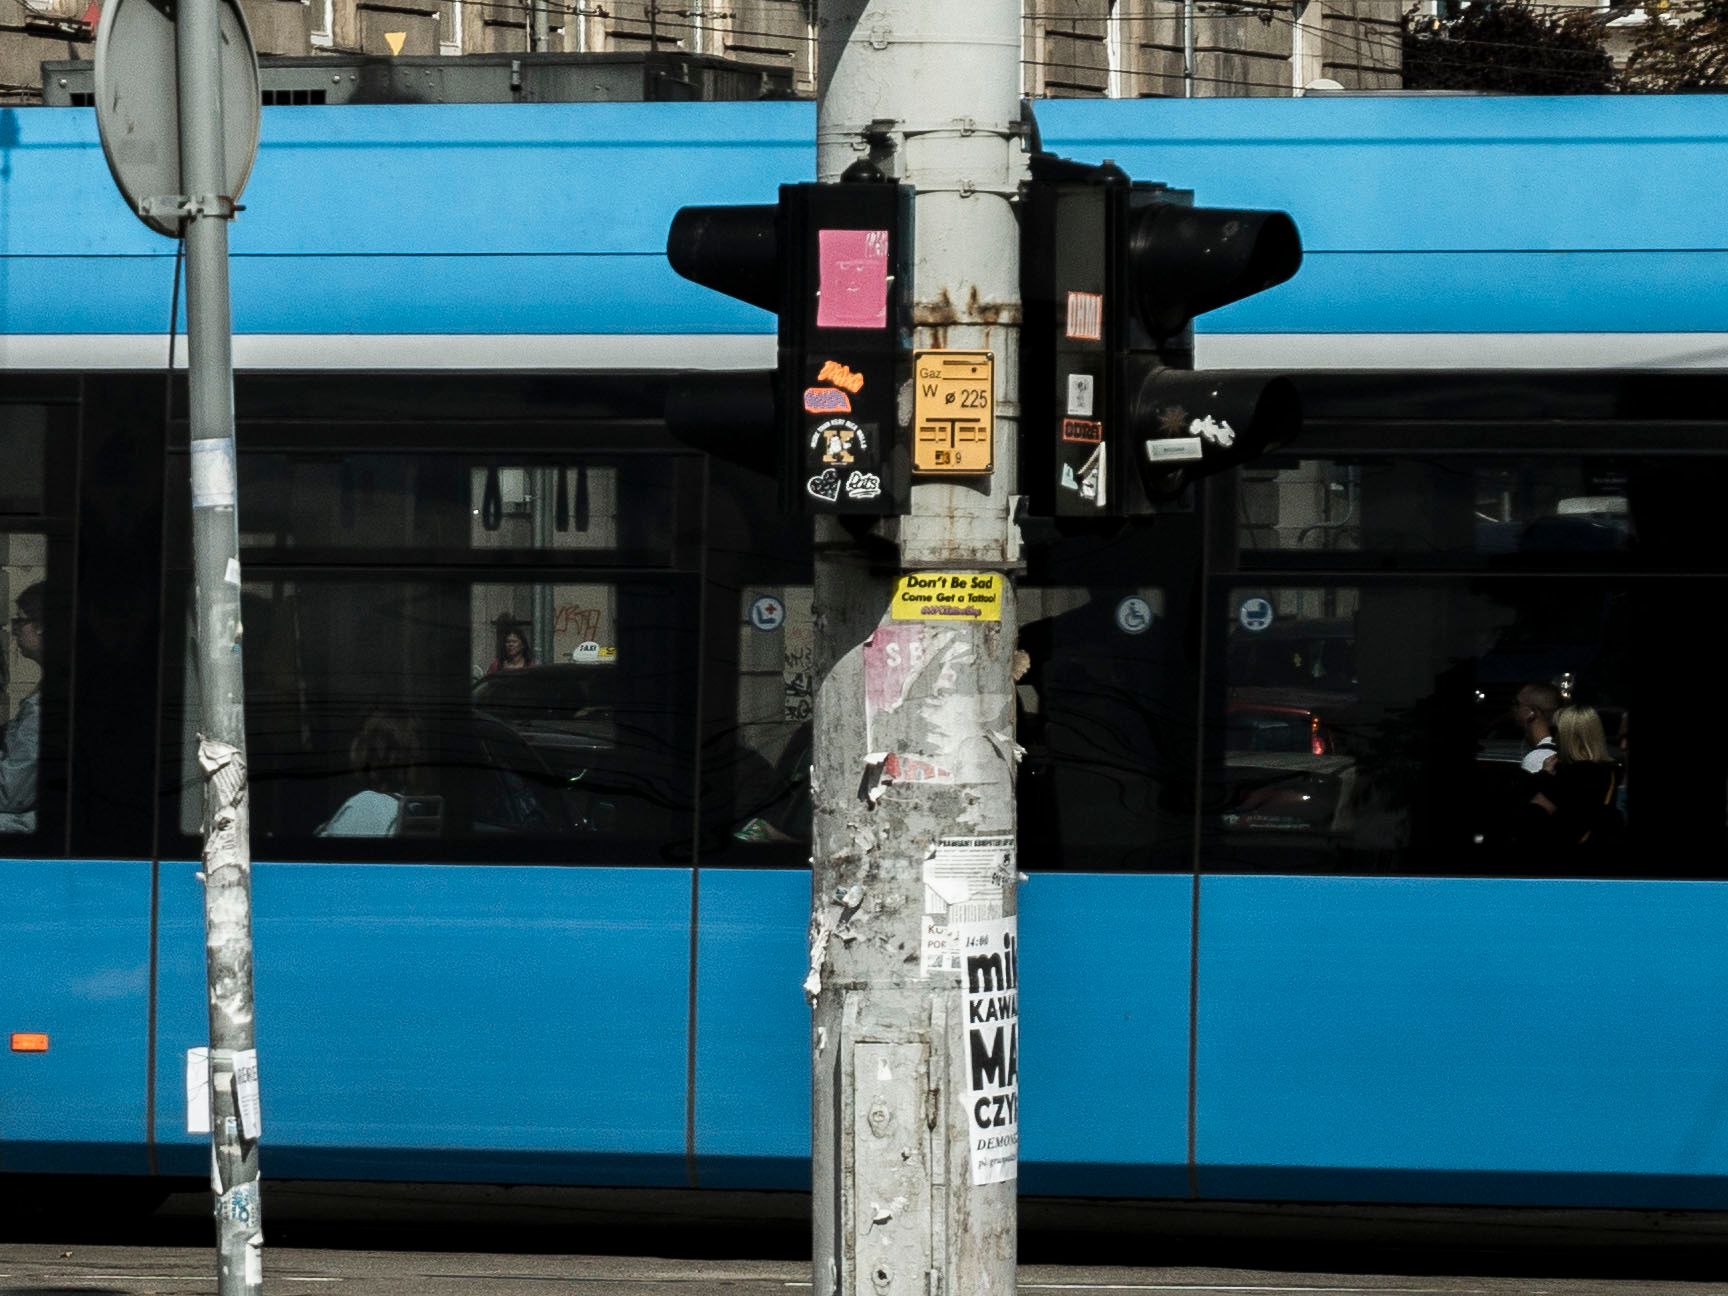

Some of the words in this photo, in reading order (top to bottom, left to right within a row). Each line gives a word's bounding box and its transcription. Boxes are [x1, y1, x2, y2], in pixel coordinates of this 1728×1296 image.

[920, 368, 942, 379] Gaz
[922, 384, 939, 397] W
[960, 389, 988, 408] 225
[950, 577, 967, 589] Be
[971, 576, 993, 589] Sad
[902, 592, 933, 602] Come
[936, 592, 955, 602] Get
[974, 1091, 1017, 1130] CZY
